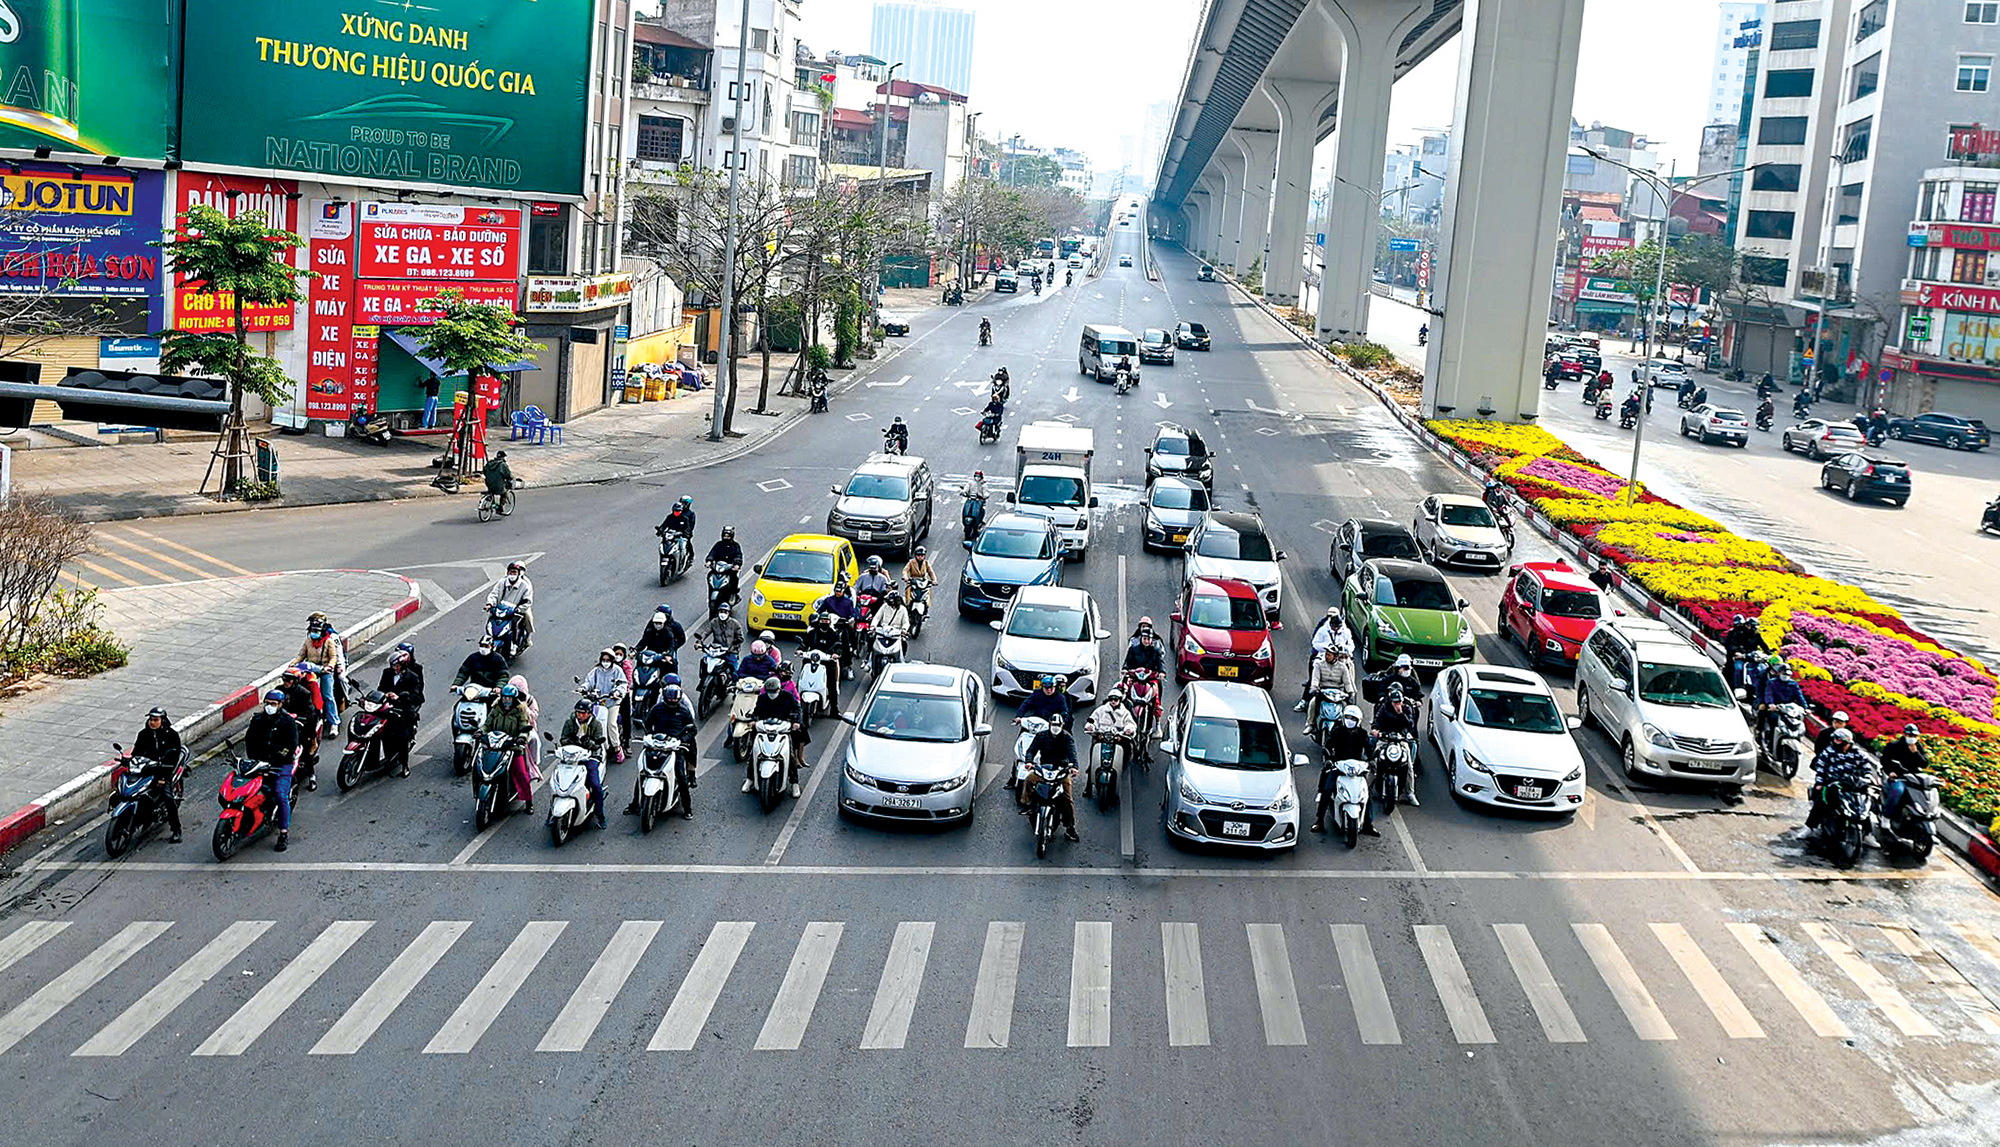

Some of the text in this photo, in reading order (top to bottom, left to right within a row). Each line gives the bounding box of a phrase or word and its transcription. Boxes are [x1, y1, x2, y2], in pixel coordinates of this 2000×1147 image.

[341, 12, 468, 51] XỨNG DANH
[255, 36, 536, 96] THƯƠNG HIỆU QUỐC GIA
[350, 125, 450, 149] PROUD TO BE
[265, 136, 521, 185] NATIONAL BRAND
[18, 180, 130, 212] JOTUN
[374, 223, 398, 239] SỬA
[401, 227, 432, 241] CHỮA
[443, 226, 466, 242] BẢO
[469, 229, 507, 243] DƯỠNG
[317, 244, 346, 265] SỬA
[375, 245, 399, 263] XE
[406, 247, 432, 264] GA
[450, 247, 474, 265] XE
[480, 243, 506, 266] SỐ
[104, 252, 157, 280] SƠN
[322, 275, 340, 290] XE
[183, 293, 214, 310] CHO
[315, 297, 346, 316] MÁY
[363, 297, 380, 312] XE
[384, 297, 401, 313] GA
[1942, 289, 1986, 309] KÍNH
[179, 316, 224, 329] HOTLINE:
[254, 315, 270, 326] 167
[273, 314, 290, 325] 959
[321, 326, 339, 341] XE
[313, 350, 346, 371] ĐIỆN
[1041, 452, 1062, 461] 24H
